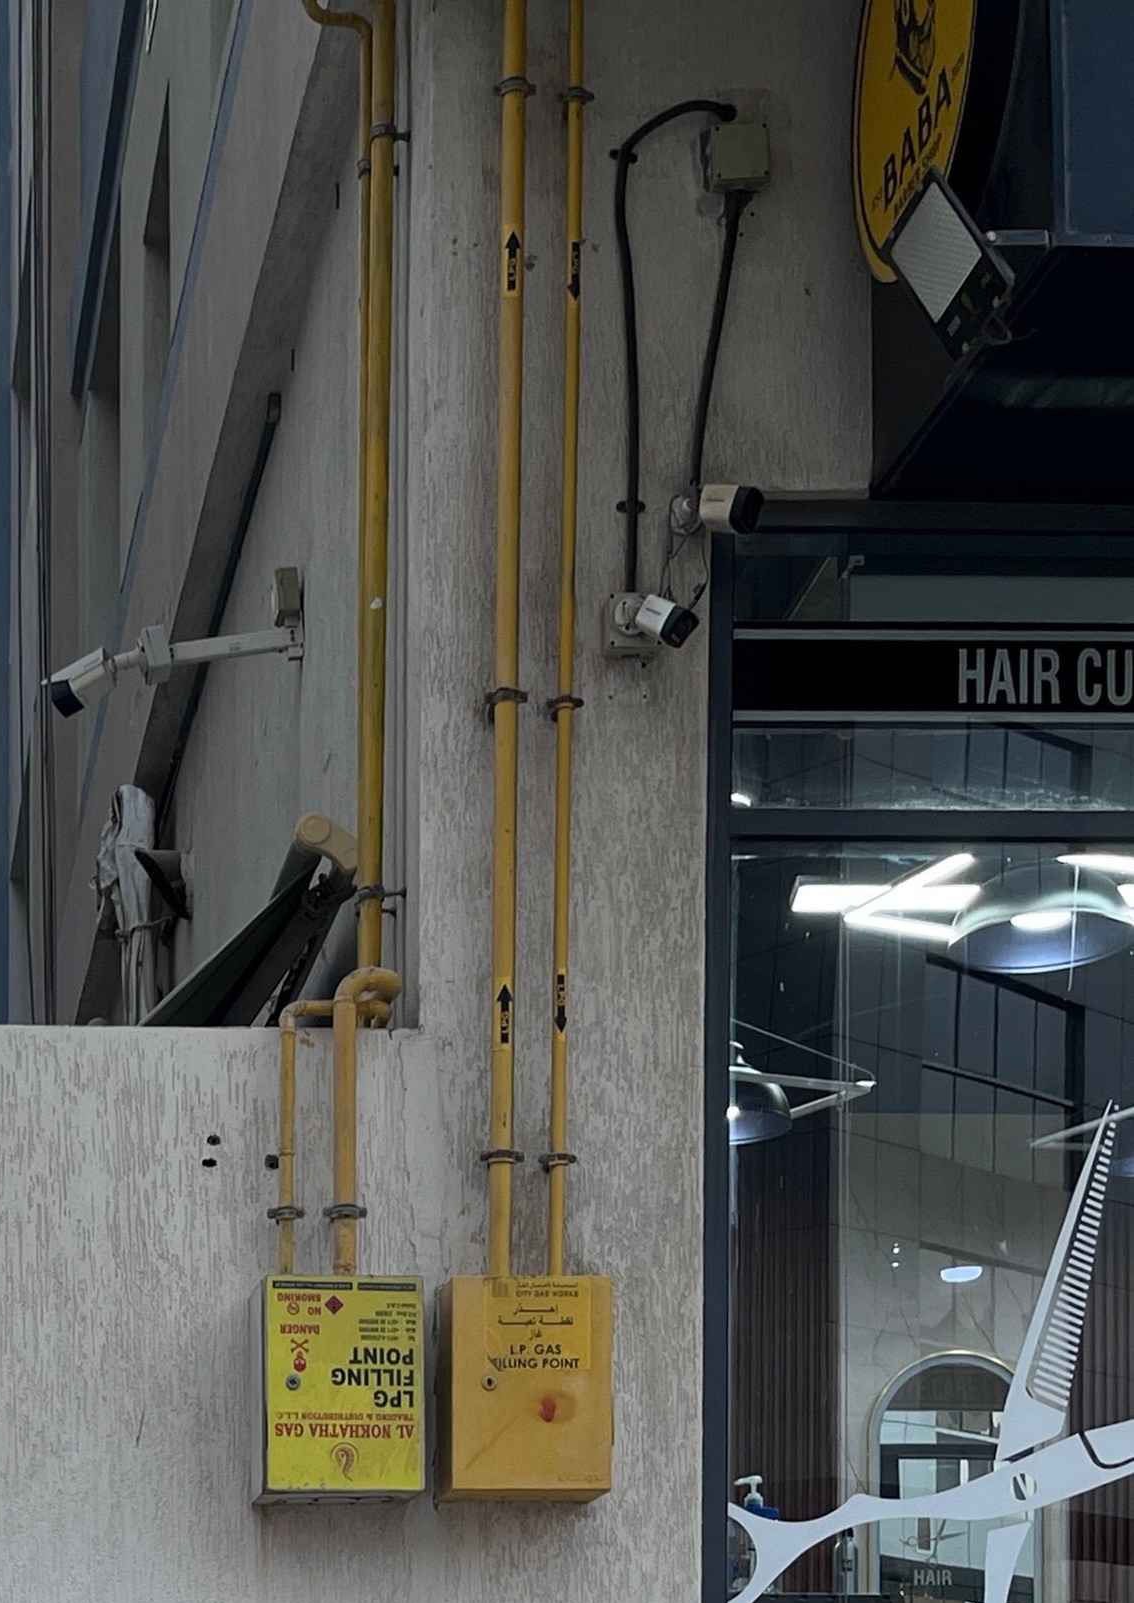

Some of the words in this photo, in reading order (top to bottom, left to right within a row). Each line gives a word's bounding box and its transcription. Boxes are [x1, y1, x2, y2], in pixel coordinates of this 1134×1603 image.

[883, 68, 952, 213] BABA
[958, 648, 1061, 704] HAIR
[277, 1292, 321, 1303] SMOKING
[307, 1306, 322, 1316] NO
[279, 1324, 320, 1335] DANGER
[349, 1346, 415, 1365] POINT
[534, 1344, 562, 1355] GAS
[542, 1358, 580, 1369] POINT
[331, 1367, 414, 1387] FILLING
[373, 1390, 415, 1408] LPG
[375, 1412, 415, 1421] TRADING
[274, 1422, 304, 1437] GAS
[308, 1423, 391, 1439] NOKHATHA
[396, 1424, 415, 1439] AL
[913, 1569, 953, 1586] HAIR
